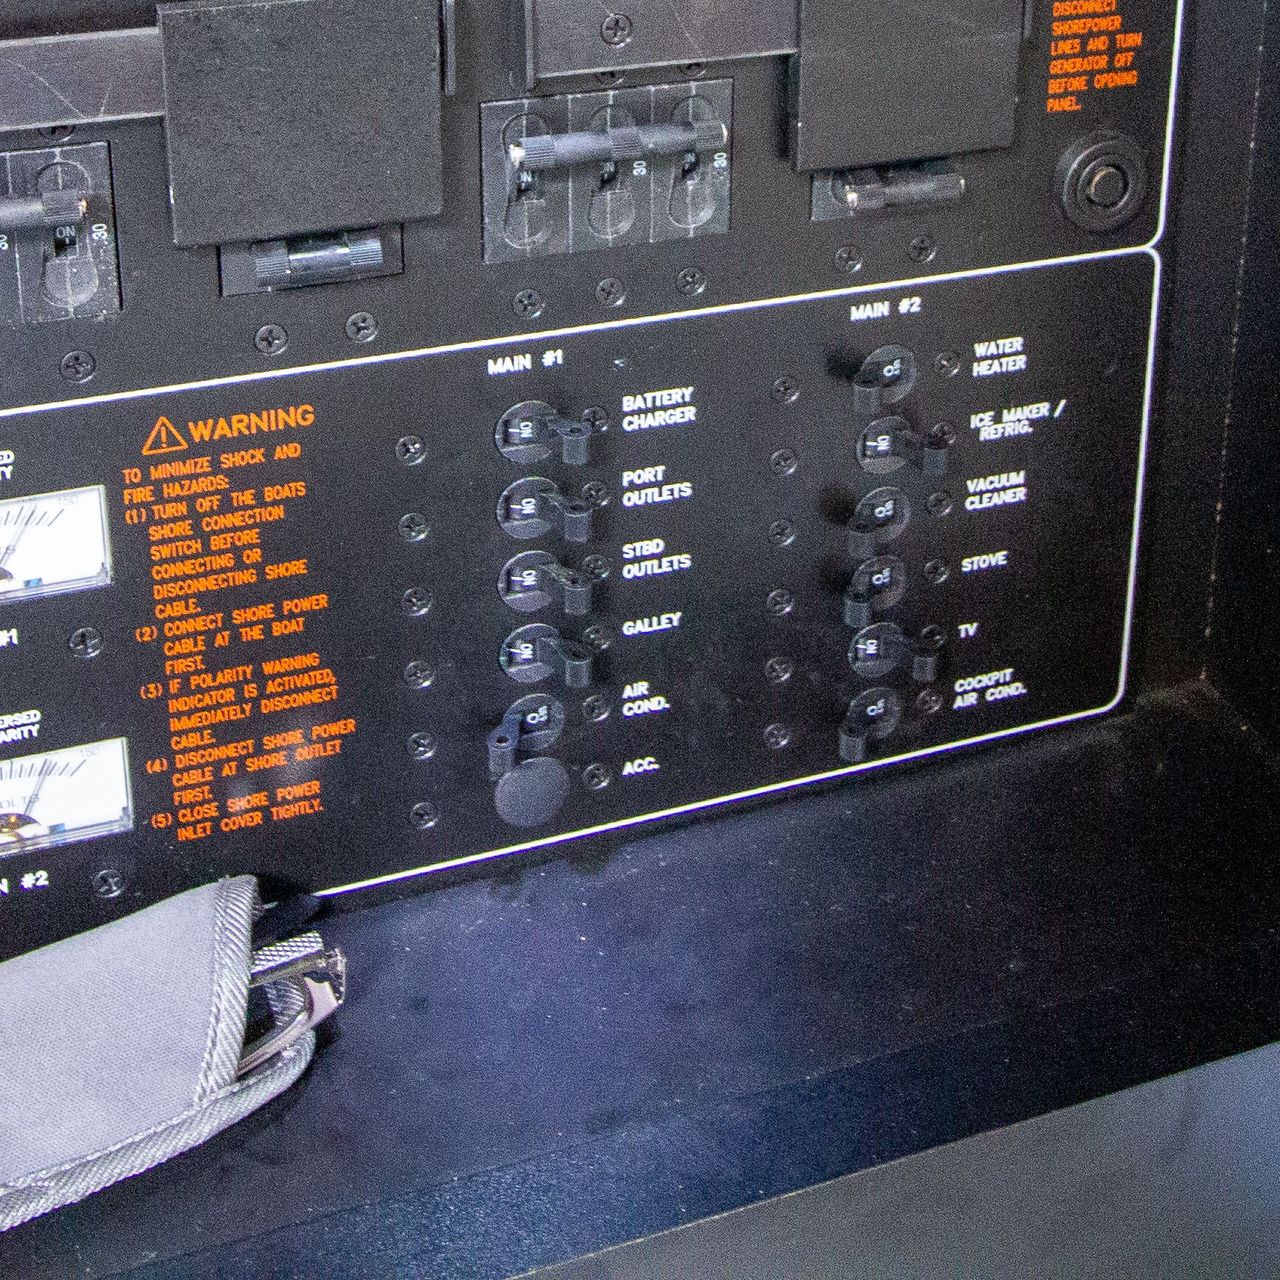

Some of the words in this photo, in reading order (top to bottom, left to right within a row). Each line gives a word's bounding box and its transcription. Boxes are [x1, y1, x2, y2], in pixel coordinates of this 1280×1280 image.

[851, 301, 889, 320] MAIN
[898, 296, 921, 313] #2
[974, 337, 1023, 357] WATER
[488, 354, 531, 374] MAIN
[542, 349, 563, 366] #1
[973, 355, 1026, 376] HEATER
[623, 387, 693, 411] BATTERY
[188, 404, 316, 442] WARNING
[623, 406, 696, 430] CHARGER
[970, 412, 995, 430] ICE
[1002, 402, 1050, 423] MAKER
[1054, 399, 1066, 418] /
[124, 467, 141, 483] TO
[150, 457, 211, 480] MINIMIZE
[220, 448, 264, 468] SHOCK
[275, 442, 301, 460] AND
[623, 465, 665, 486] PORT
[967, 471, 1025, 492] VACUUM
[124, 486, 153, 503] FIRE
[152, 501, 188, 519] TURN
[195, 495, 220, 513] OFF
[231, 489, 255, 505] THE
[264, 481, 305, 501] BOATS
[623, 482, 692, 506] OUTLETS
[965, 487, 1026, 510] CLEANER
[622, 538, 665, 558] STBD
[623, 554, 691, 578] OUTLETS
[962, 551, 1007, 571] STOVE
[164, 613, 222, 636] CONNECT
[233, 604, 274, 623] SHORE
[283, 594, 328, 613] POWER
[622, 612, 682, 635] GALLEY
[958, 622, 978, 637] TV
[622, 682, 649, 698] AIR
[954, 668, 1013, 692] COCKPIT
[953, 691, 978, 709] AIR
[177, 821, 212, 840] INLET
[221, 810, 262, 831] COVER
[21, 870, 49, 888] #2
